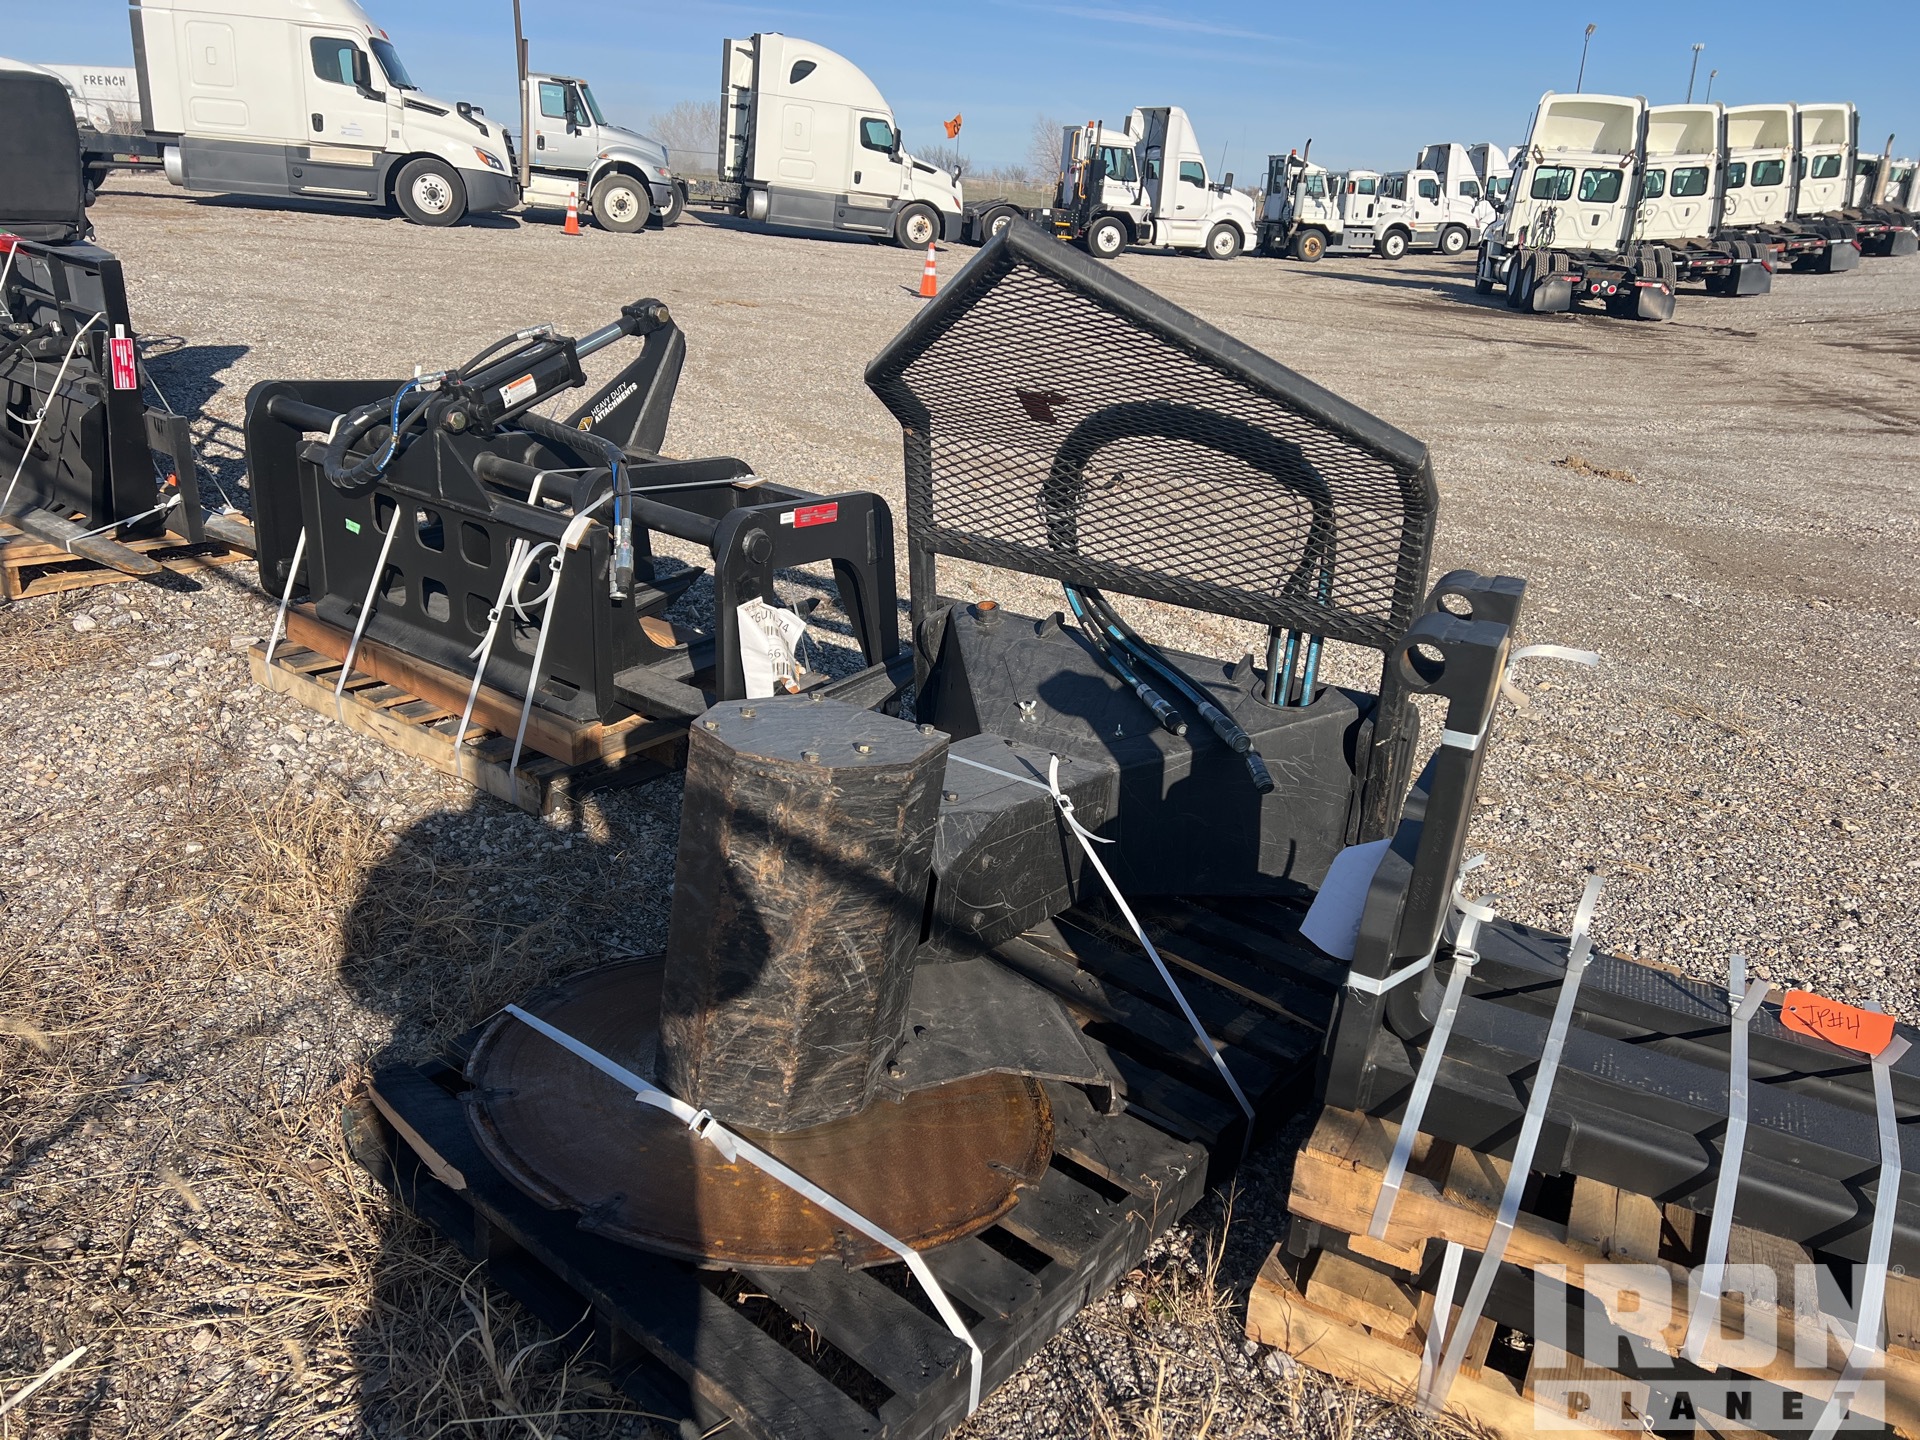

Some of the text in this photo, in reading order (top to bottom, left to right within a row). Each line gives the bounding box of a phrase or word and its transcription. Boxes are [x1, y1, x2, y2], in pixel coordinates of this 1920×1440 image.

[83, 75, 126, 86] FRENCH
[590, 381, 627, 416] HEAVY DUTY
[594, 382, 638, 424] ATTACHMENTS
